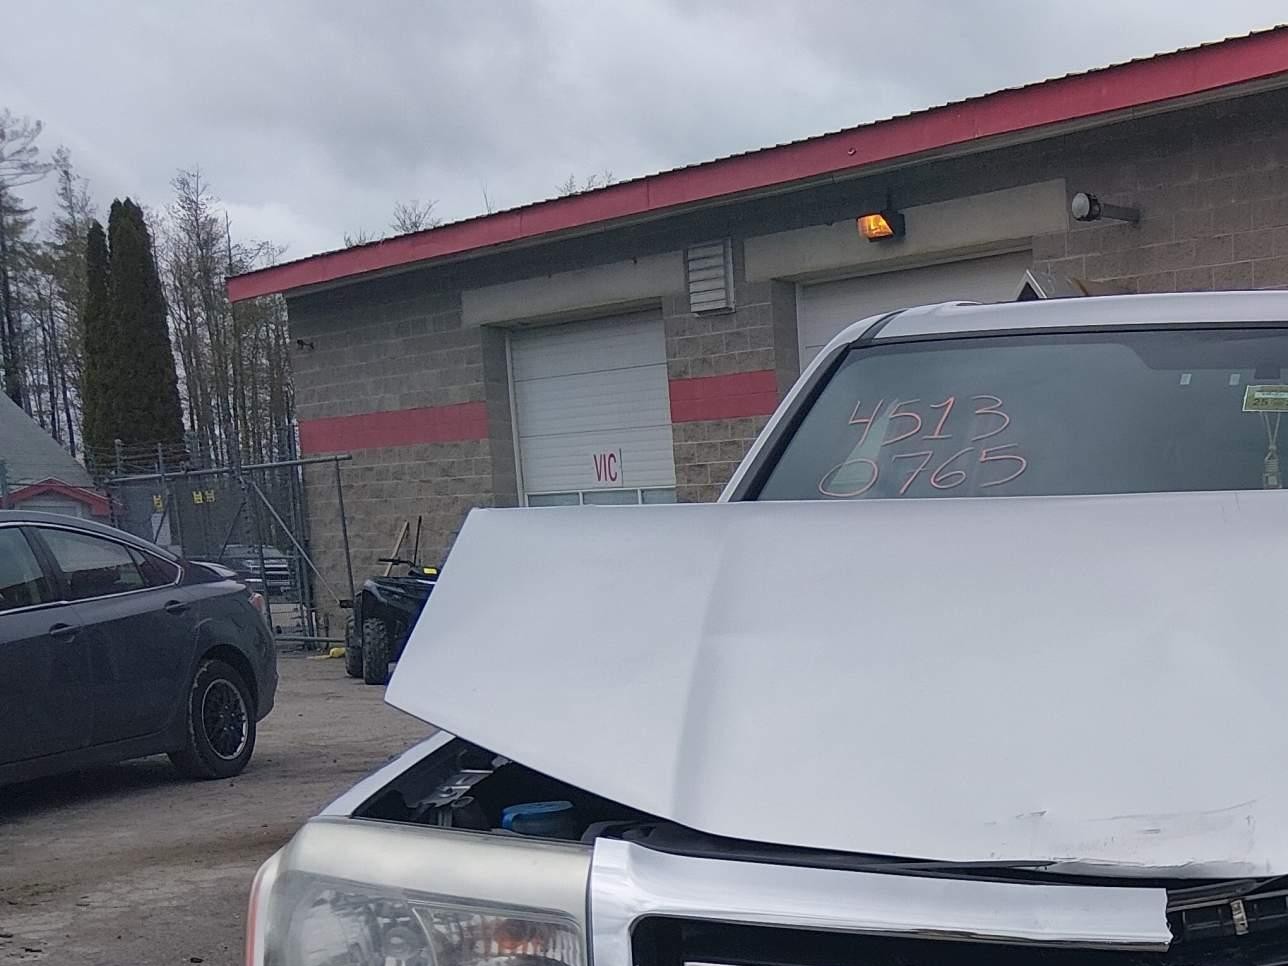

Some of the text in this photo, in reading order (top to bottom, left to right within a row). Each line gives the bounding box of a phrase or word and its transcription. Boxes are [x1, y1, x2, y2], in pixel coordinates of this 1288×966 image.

[848, 395, 1010, 447] 4513
[593, 453, 618, 481] VIC
[818, 443, 1027, 497] 0765
